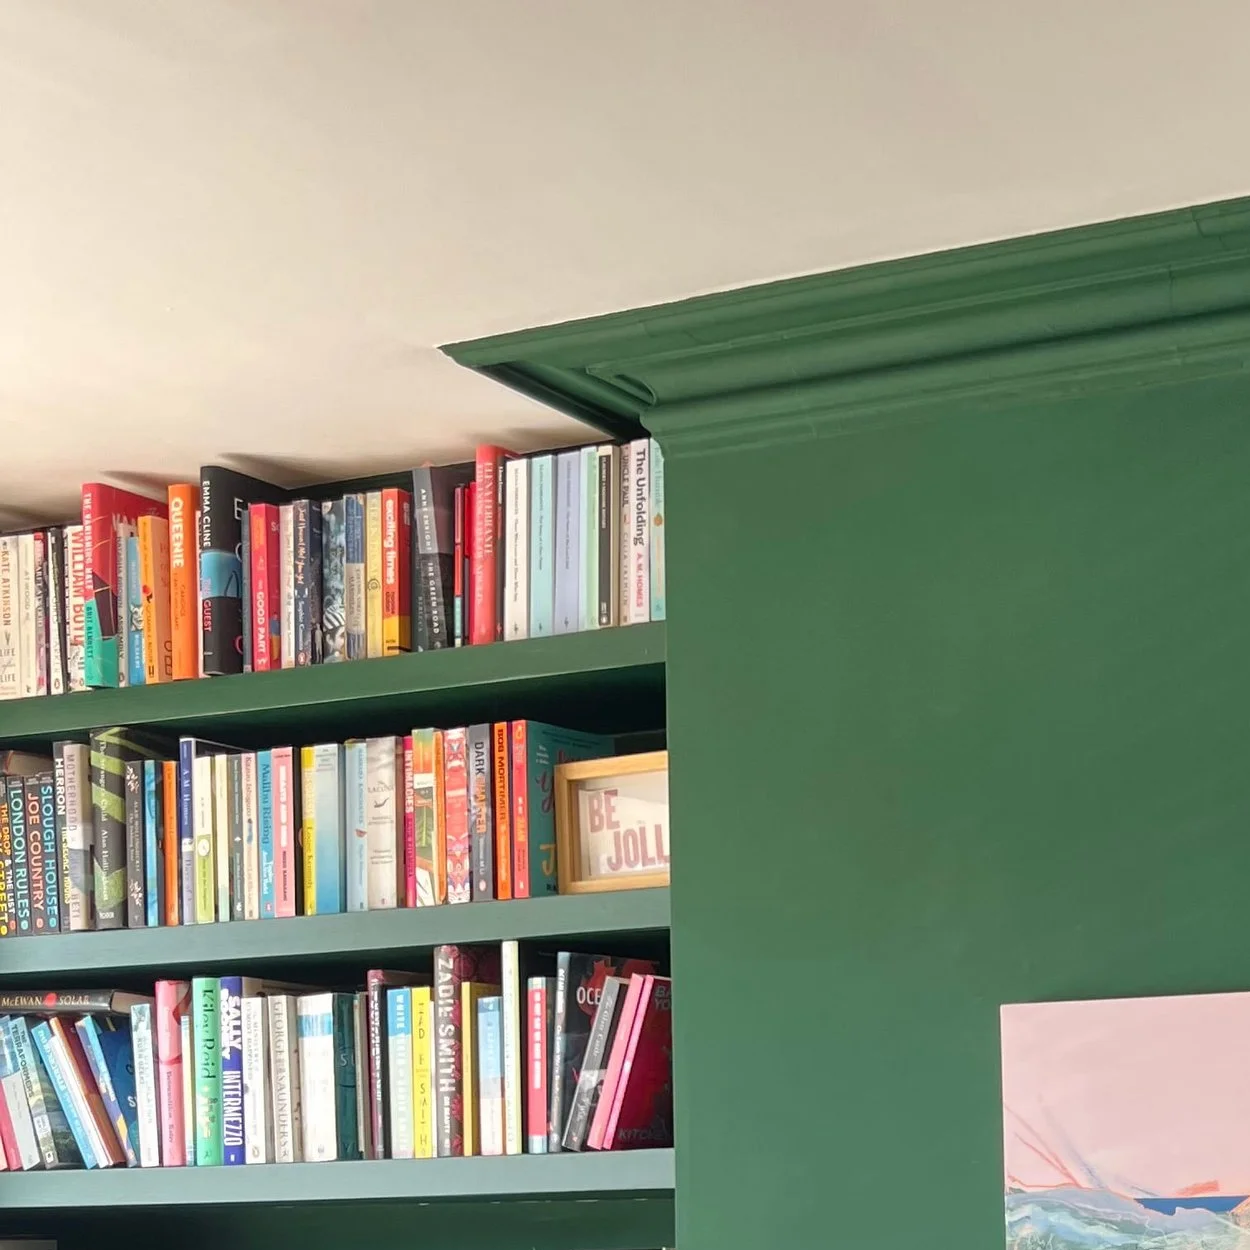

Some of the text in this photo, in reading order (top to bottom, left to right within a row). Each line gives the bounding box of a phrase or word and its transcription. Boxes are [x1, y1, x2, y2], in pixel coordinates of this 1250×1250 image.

[634, 449, 647, 546] The Unfolding
[171, 498, 184, 569] QUEENIE
[203, 516, 211, 547] CLINE
[384, 500, 396, 585] exciting times
[423, 515, 432, 552] ENRIGHT
[2, 551, 11, 626] KATE ATKINSON
[71, 531, 84, 598] WILLIAM
[429, 581, 438, 607] GREEN
[256, 592, 266, 653] GOOD PART
[432, 610, 440, 634] ROAD
[55, 758, 66, 816] HERRON
[405, 750, 414, 813] INTIMACIES
[474, 742, 485, 775] DARK
[497, 757, 506, 820] MORTIMER
[67, 754, 78, 831] MOTHERHOOD
[261, 763, 271, 844] Malibu Rising
[588, 789, 620, 833] BE
[5, 859, 12, 867] &
[10, 790, 30, 918] LONDON RULES
[28, 793, 44, 911] JOE COUNTRY
[41, 786, 58, 916] SLOUGH HOUSE
[607, 824, 670, 871] JOLL
[71, 894, 80, 919] HETI
[2, 996, 42, 1007] McEWAN
[59, 994, 90, 1006] SOLAR
[229, 996, 241, 1050] SALLY
[438, 958, 456, 1092] ZADIE SMITH
[12, 1024, 36, 1098] TERRAFORMERS
[201, 989, 216, 1078] Kiley Reid
[222, 1070, 242, 1146] INTERMEZZO
[276, 1076, 289, 1147] SAUNDERS
